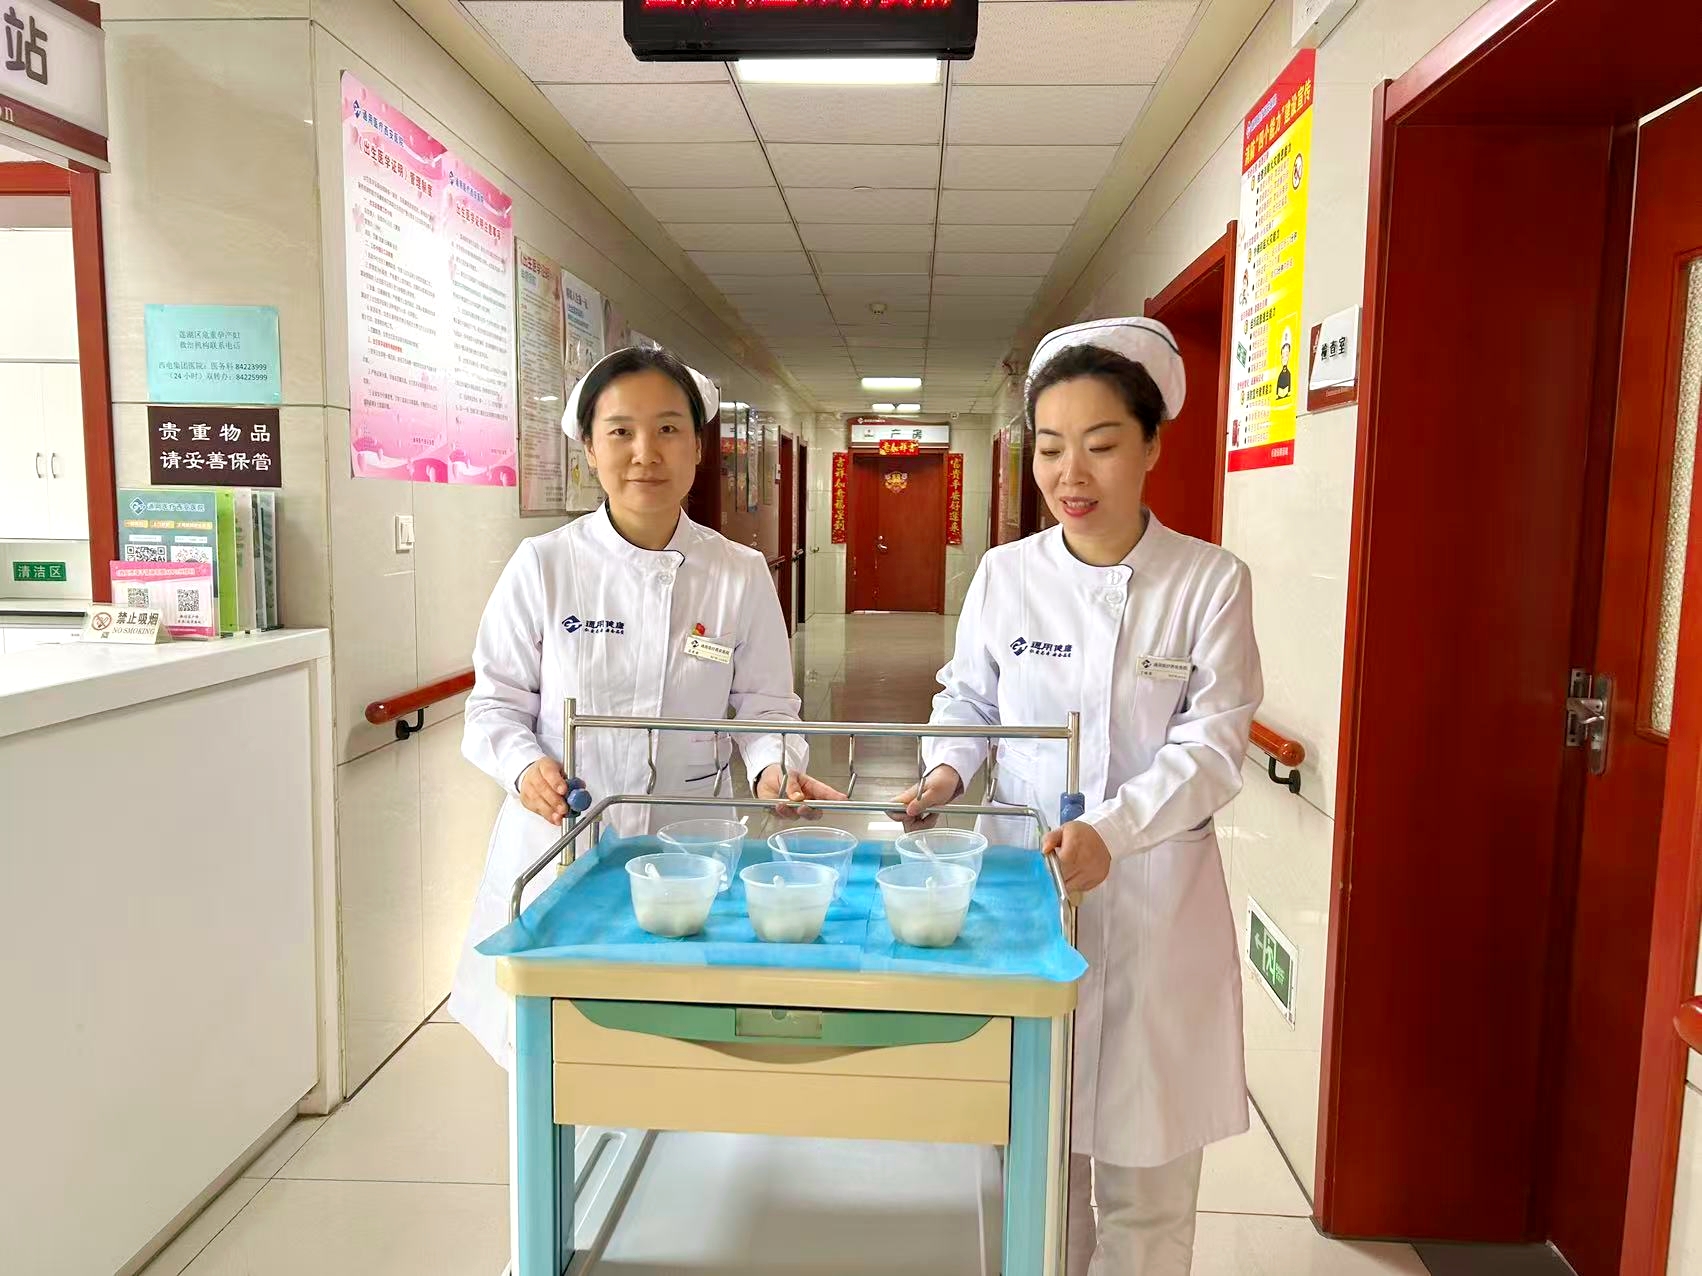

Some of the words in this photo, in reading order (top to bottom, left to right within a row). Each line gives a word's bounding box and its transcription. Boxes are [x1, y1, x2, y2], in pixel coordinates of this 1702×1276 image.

[3, 6, 48, 85] 站
[1321, 336, 1347, 361] 检查室
[235, 363, 268, 372] 84223999
[235, 374, 268, 382] 84225999
[158, 421, 271, 442] 贵重物品
[159, 450, 272, 471] 请妥善保管
[18, 564, 62, 578] 清洁区
[115, 611, 160, 627] 禁止吸烟
[585, 620, 625, 630] 通用健康
[112, 626, 123, 634] NO
[123, 627, 156, 636] SMOKING
[1030, 640, 1073, 652] 通用健康
